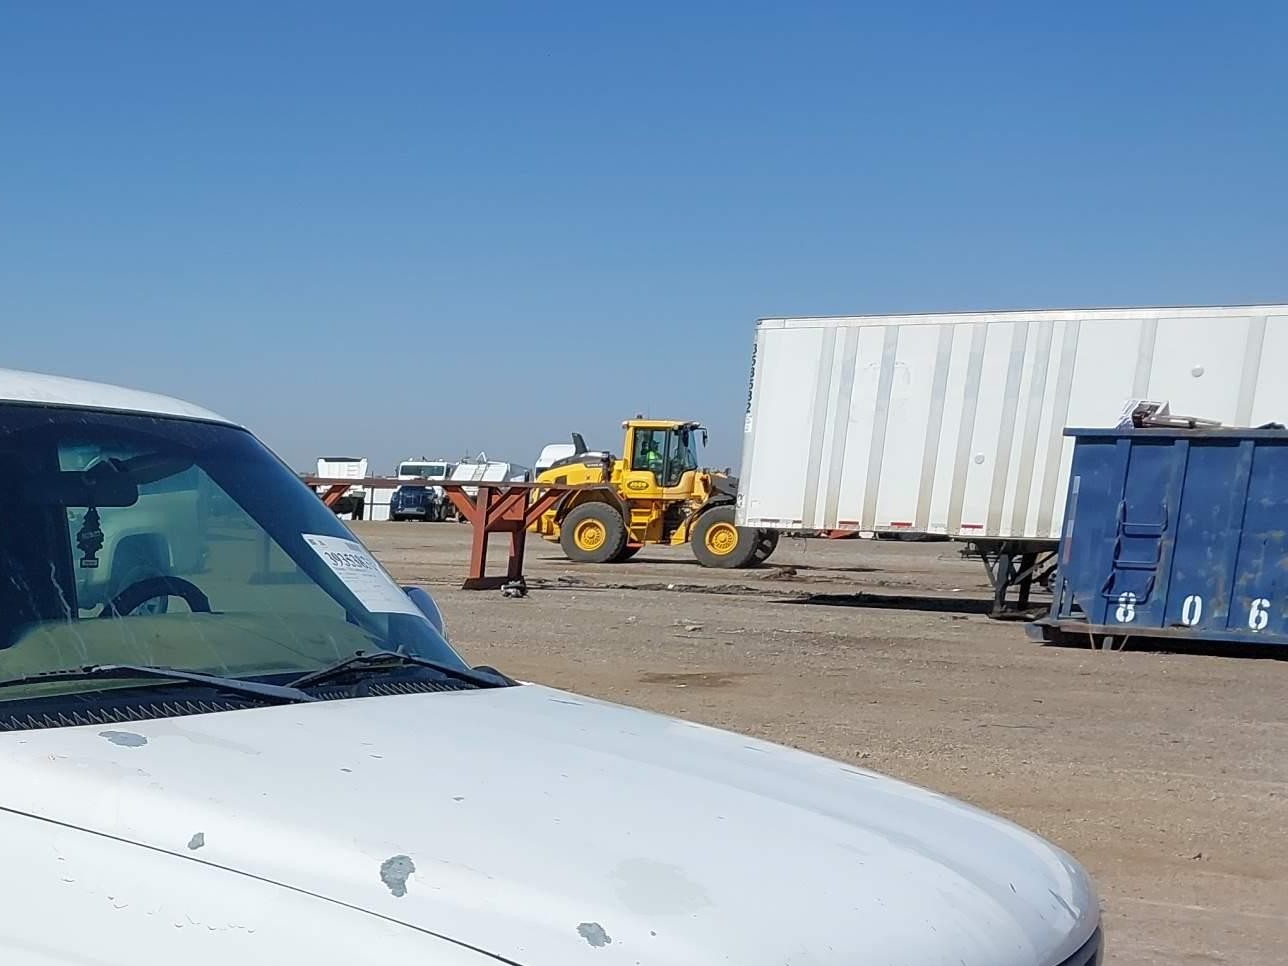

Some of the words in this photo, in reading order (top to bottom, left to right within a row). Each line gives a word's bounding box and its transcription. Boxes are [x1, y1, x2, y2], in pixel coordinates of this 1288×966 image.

[324, 551, 378, 572] 393538
[1115, 591, 1137, 623] 8
[1182, 594, 1203, 625] 0
[1248, 598, 1271, 630] 6
